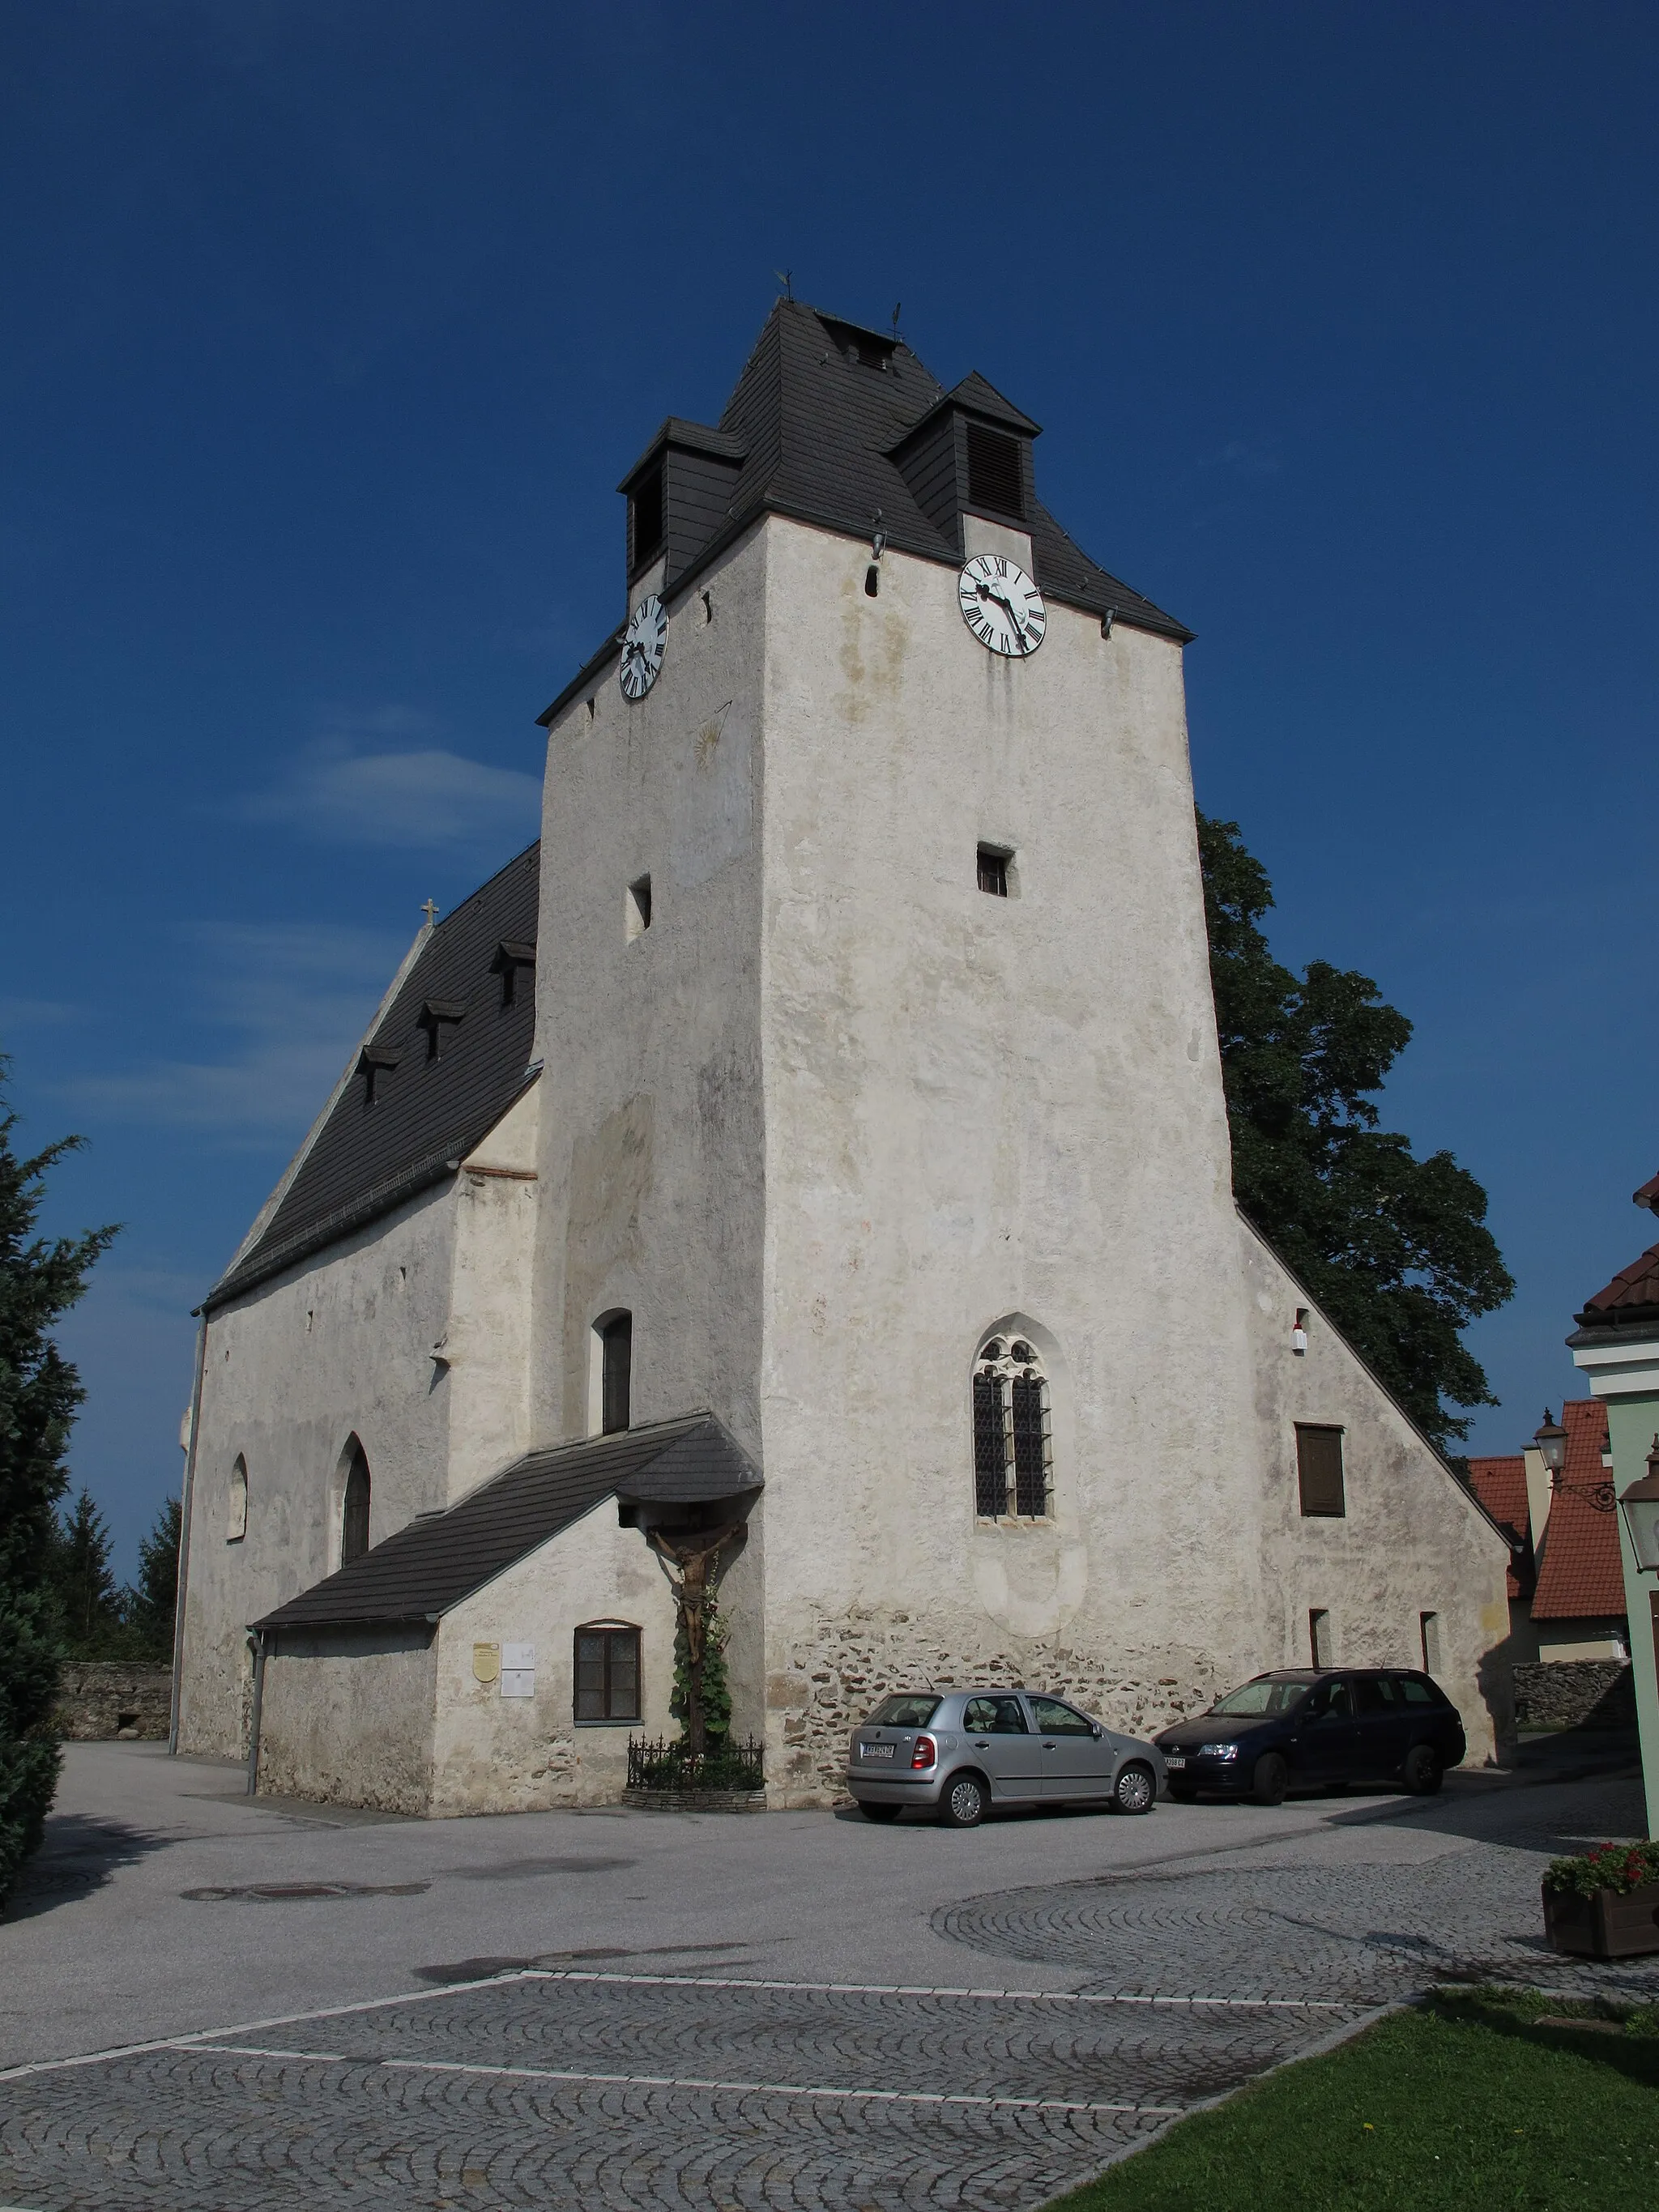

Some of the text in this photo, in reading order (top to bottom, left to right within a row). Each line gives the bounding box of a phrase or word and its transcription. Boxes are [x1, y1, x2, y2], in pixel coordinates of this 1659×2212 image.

[976, 557, 992, 578] XI
[994, 557, 1008, 578] XII
[1014, 571, 1022, 585] I
[1024, 590, 1038, 600] II
[964, 606, 984, 628] VIII
[979, 622, 995, 644] VII
[1000, 633, 1011, 654] VI
